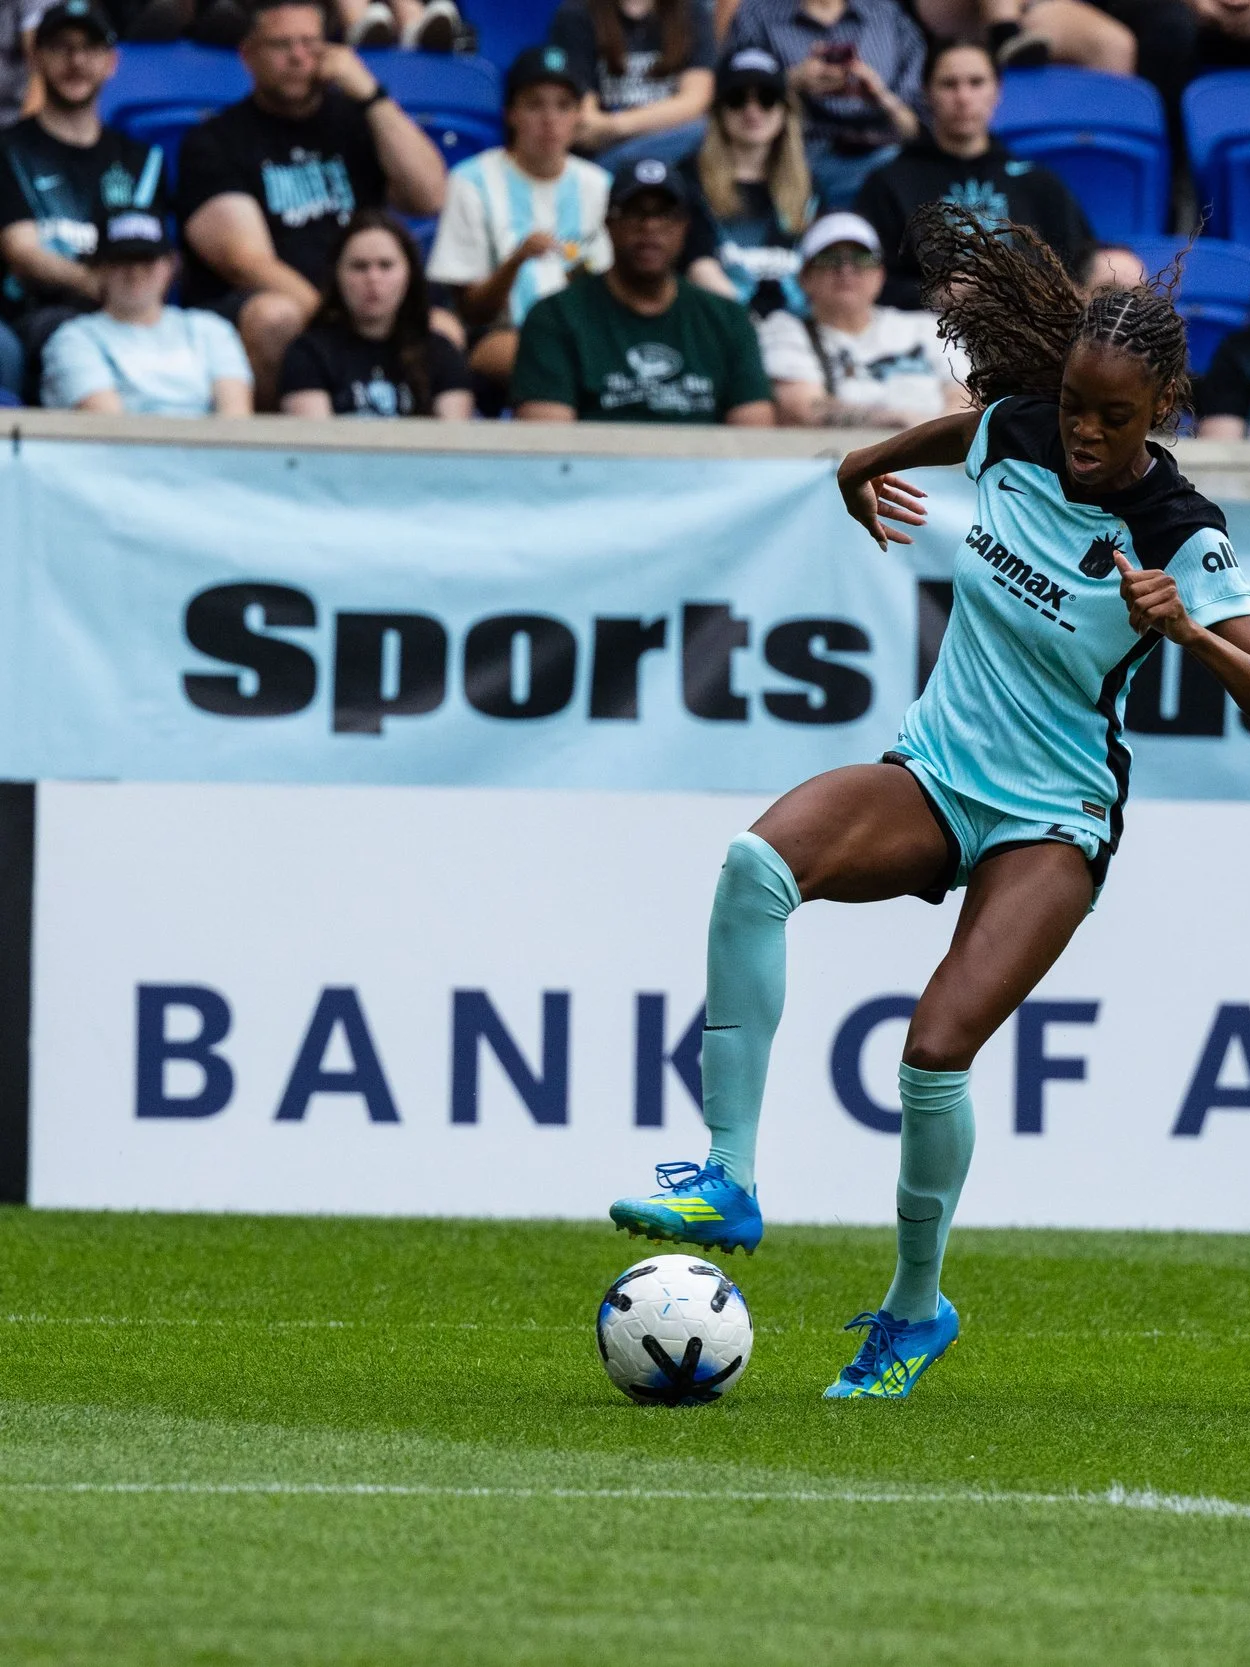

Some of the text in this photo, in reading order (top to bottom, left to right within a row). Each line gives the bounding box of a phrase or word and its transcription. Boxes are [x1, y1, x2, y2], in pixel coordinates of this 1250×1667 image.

[1202, 542, 1239, 573] all
[183, 583, 875, 735] Sports
[136, 983, 707, 1127] BANK
